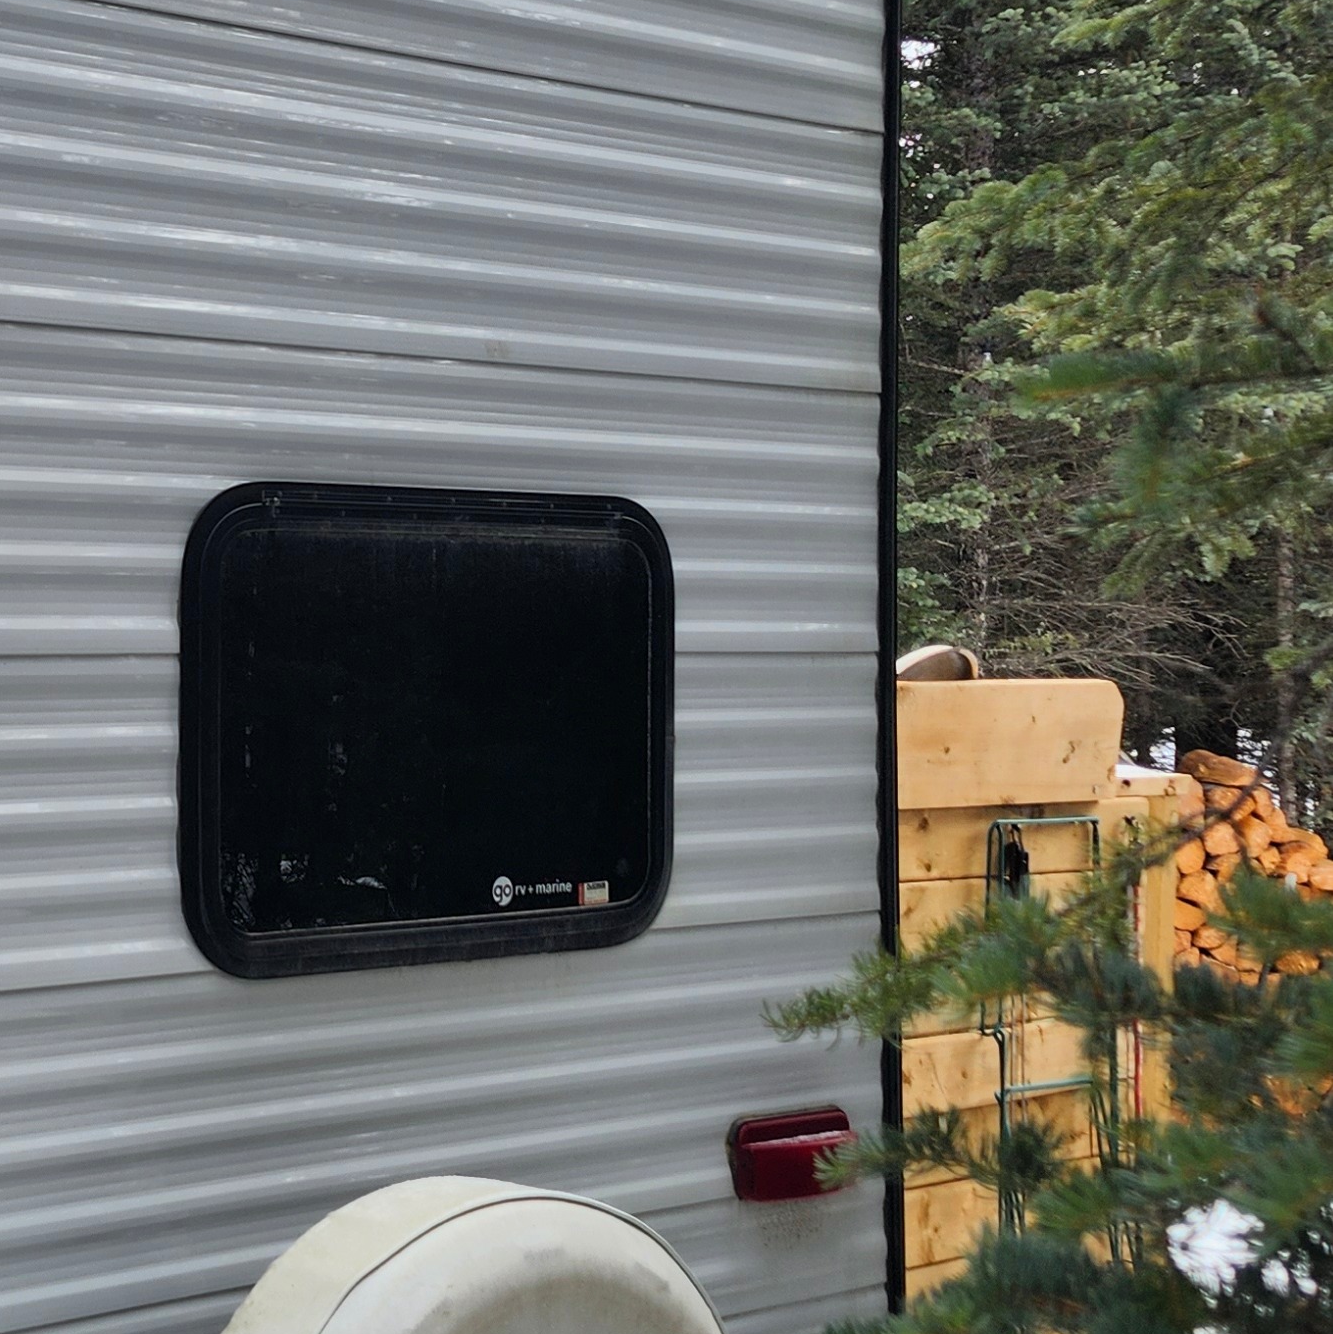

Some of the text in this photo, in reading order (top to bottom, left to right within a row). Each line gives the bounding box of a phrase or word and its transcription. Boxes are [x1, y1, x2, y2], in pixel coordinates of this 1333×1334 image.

[493, 883, 513, 904] go
[515, 884, 526, 896] rv
[535, 878, 573, 895] marine
